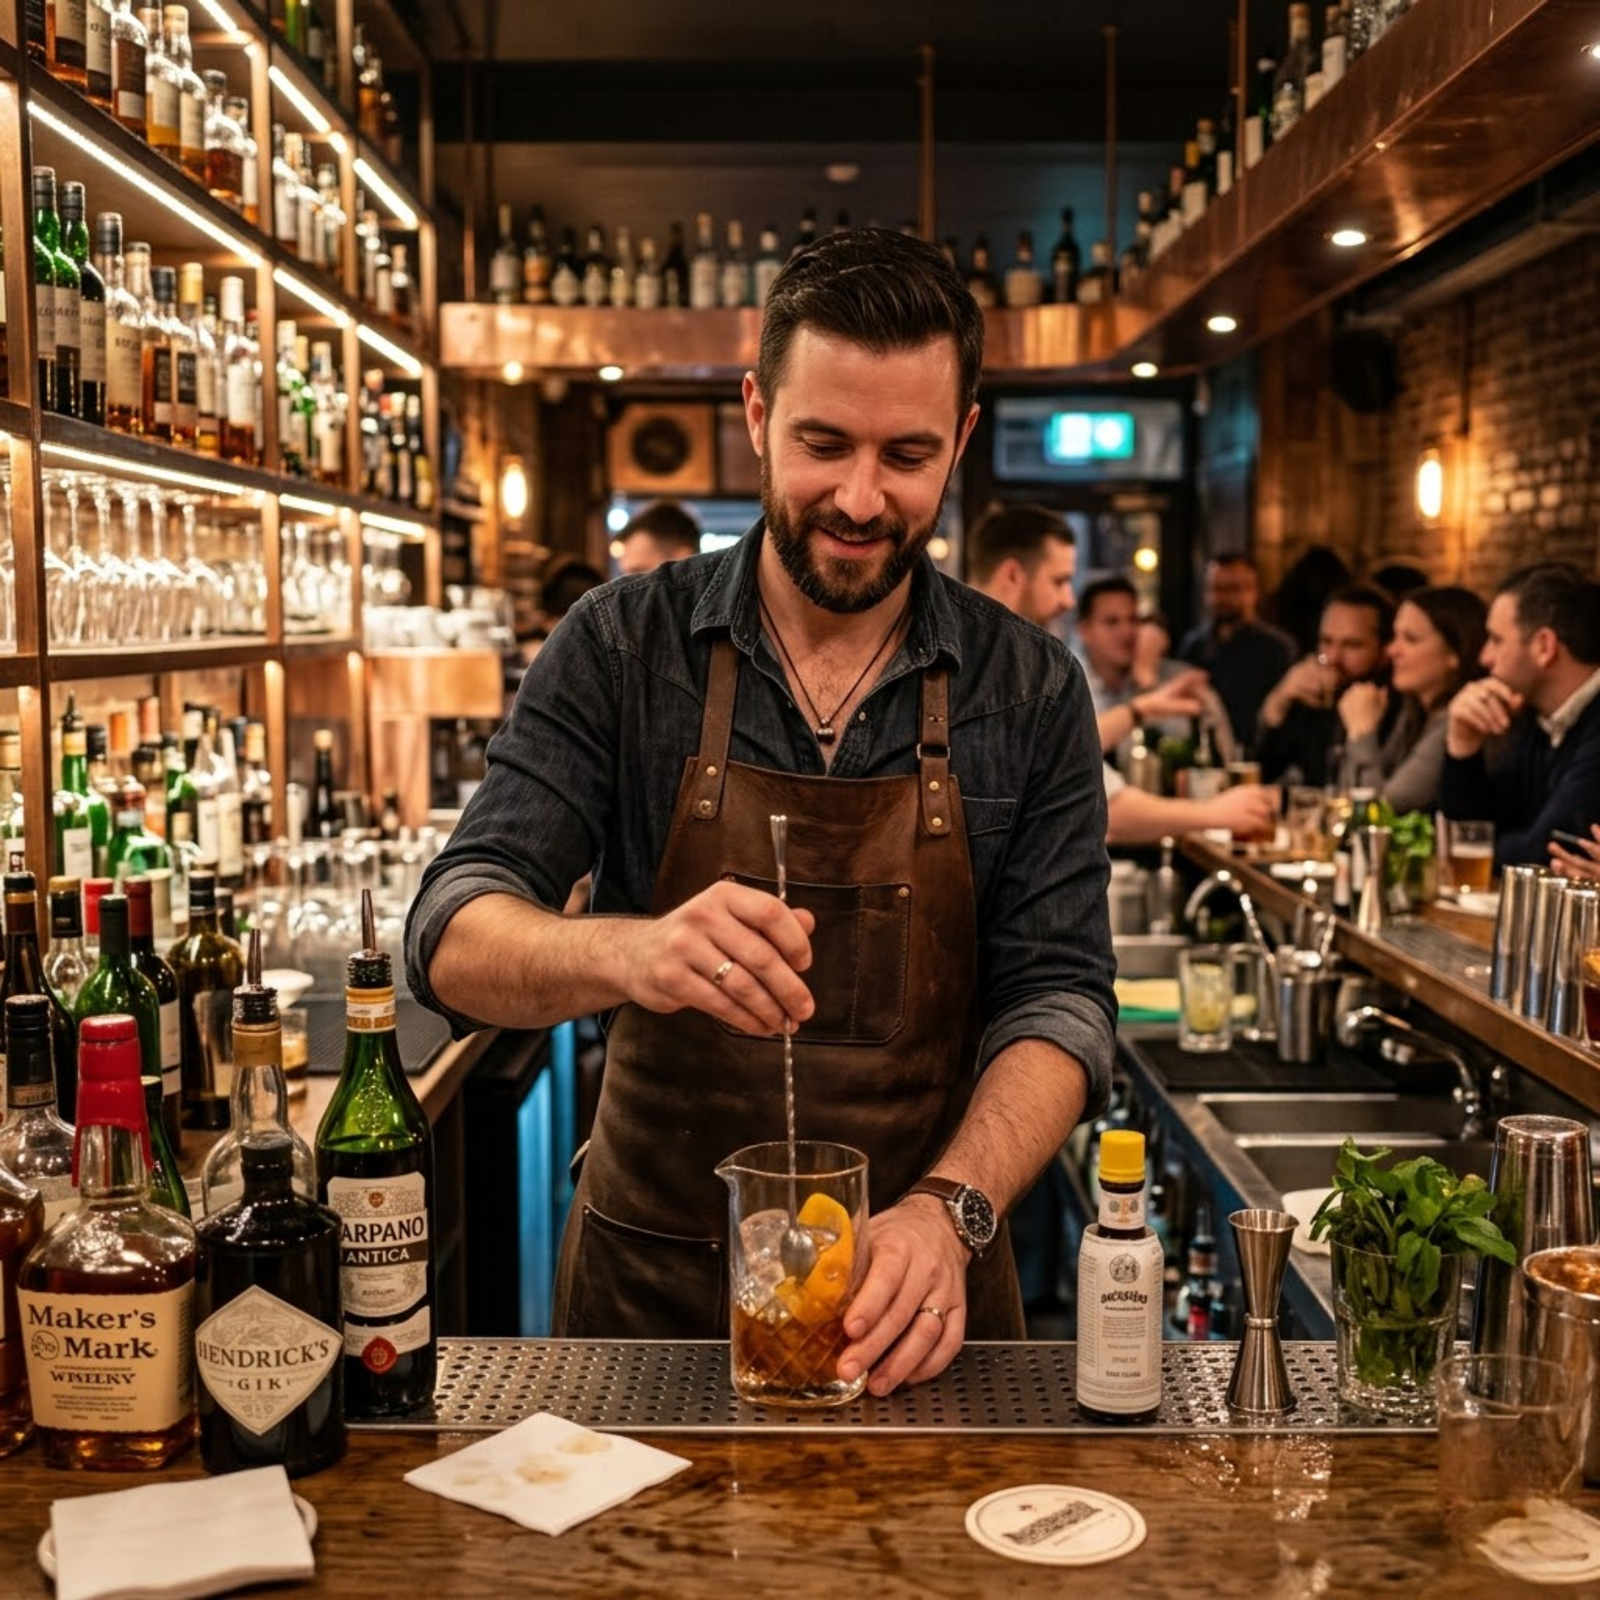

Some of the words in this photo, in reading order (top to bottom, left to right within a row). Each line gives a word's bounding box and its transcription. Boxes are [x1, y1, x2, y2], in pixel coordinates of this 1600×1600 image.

[341, 1216, 424, 1243] ARPANO
[346, 1247, 410, 1264] ANTICA
[27, 1304, 157, 1330] Maker's
[63, 1336, 158, 1360] Mark
[199, 1339, 329, 1368] HENDRICK'S
